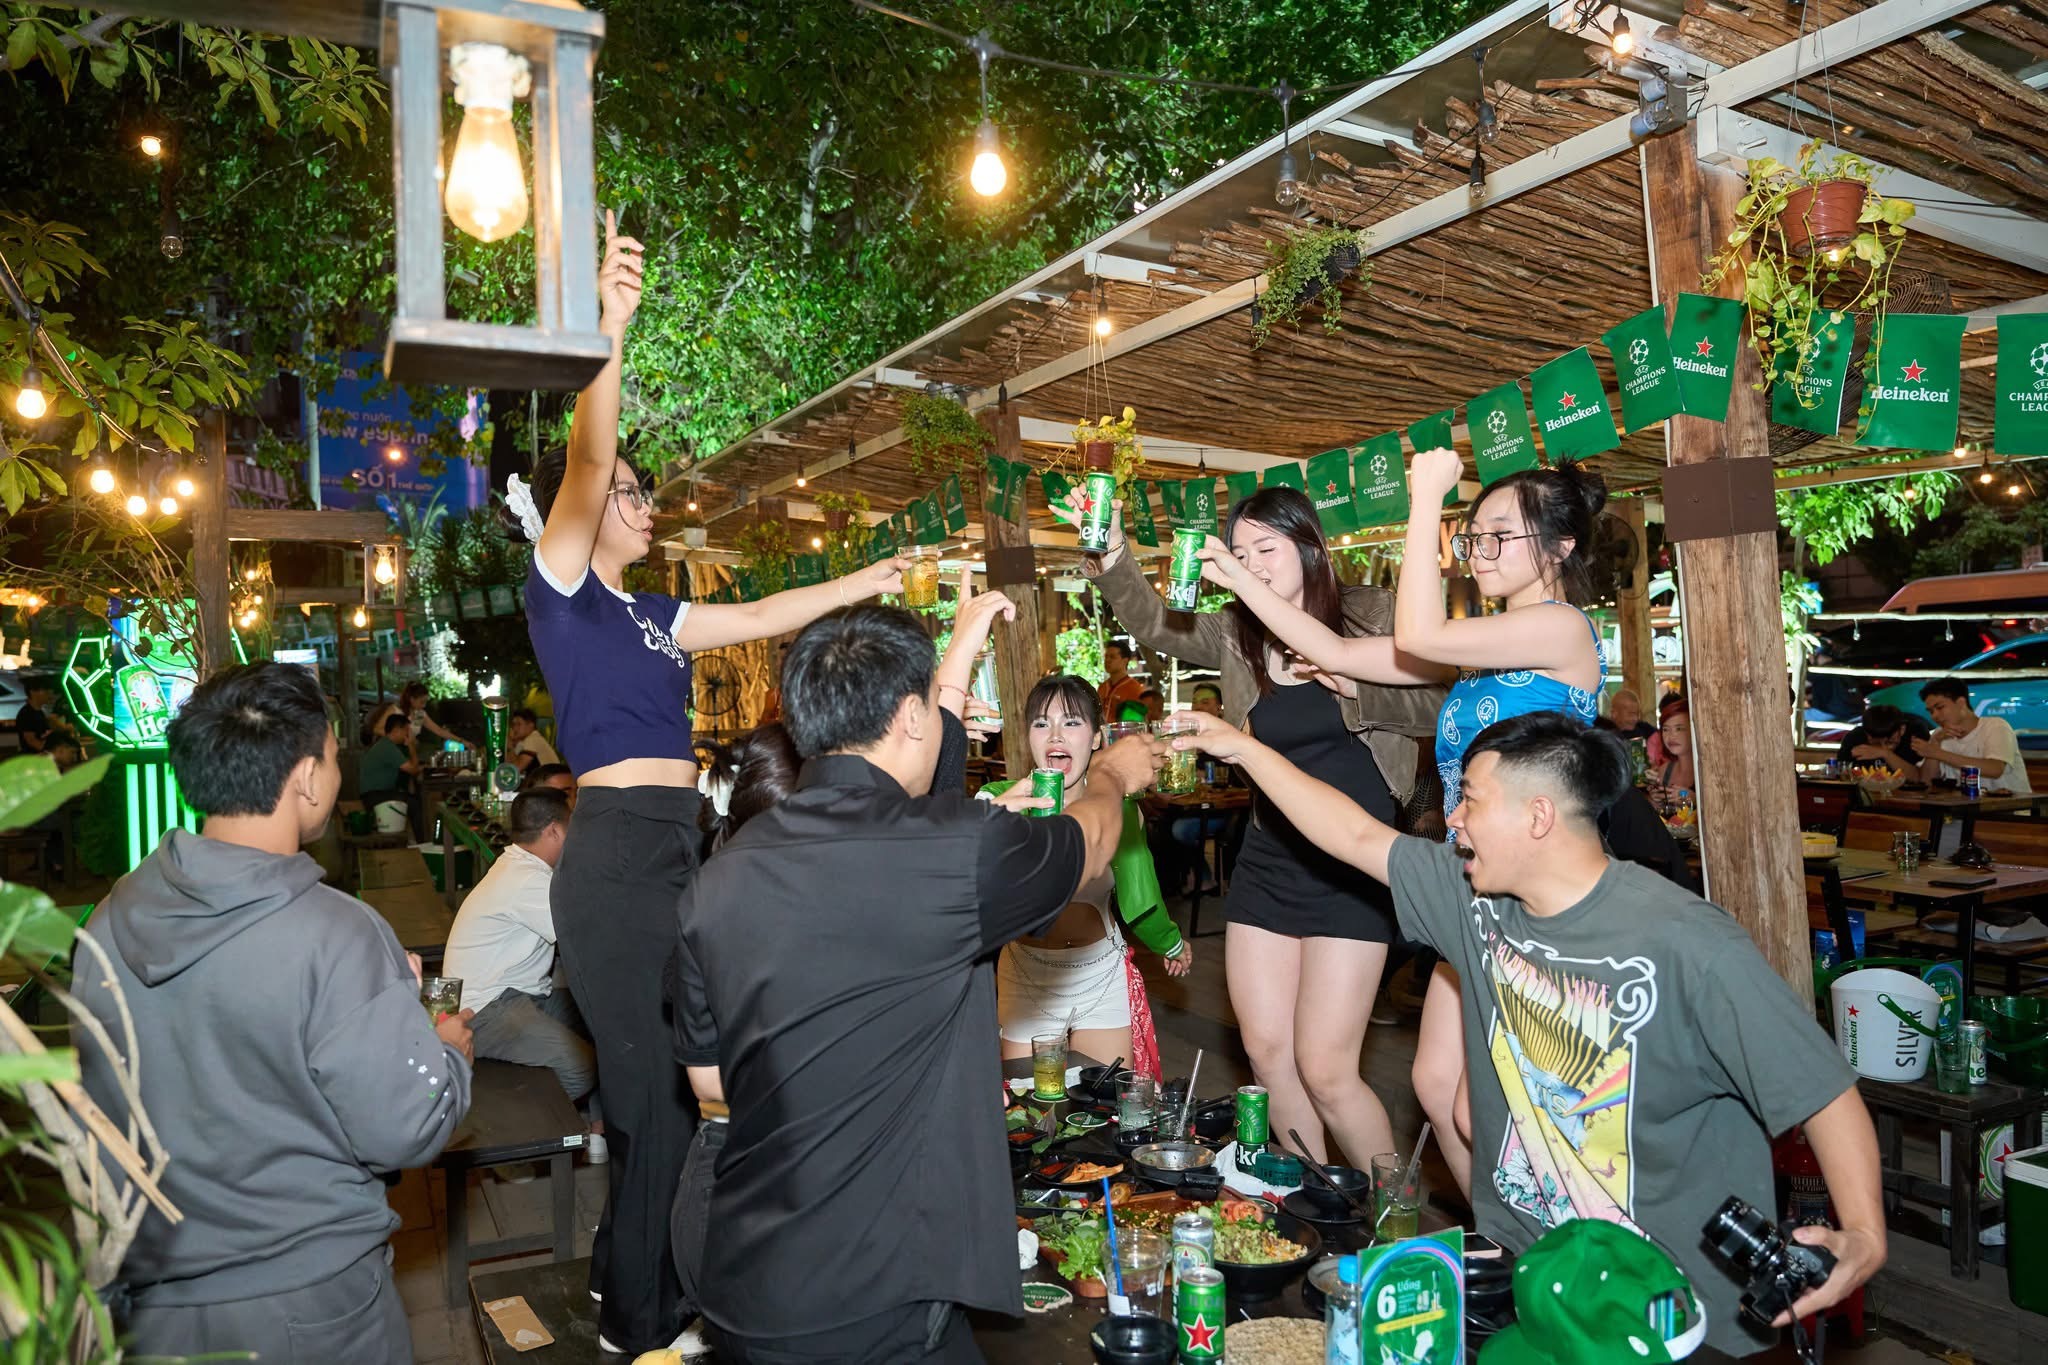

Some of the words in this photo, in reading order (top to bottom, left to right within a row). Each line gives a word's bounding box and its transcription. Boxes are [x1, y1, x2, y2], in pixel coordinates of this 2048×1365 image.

[1625, 366, 1667, 391] CHAMPIONS
[1631, 378, 1660, 396] LEAGUE
[1790, 382, 1822, 395] LAGUE
[1545, 403, 1600, 432] Heineken
[1482, 436, 1524, 457] CHAMPIONS
[1491, 445, 1520, 461] LEAGUE
[1363, 480, 1400, 495] CHAMPIONS
[1370, 489, 1395, 500] LEAGUE
[1316, 496, 1350, 510] Heineken
[1377, 1284, 1397, 1320] 6
